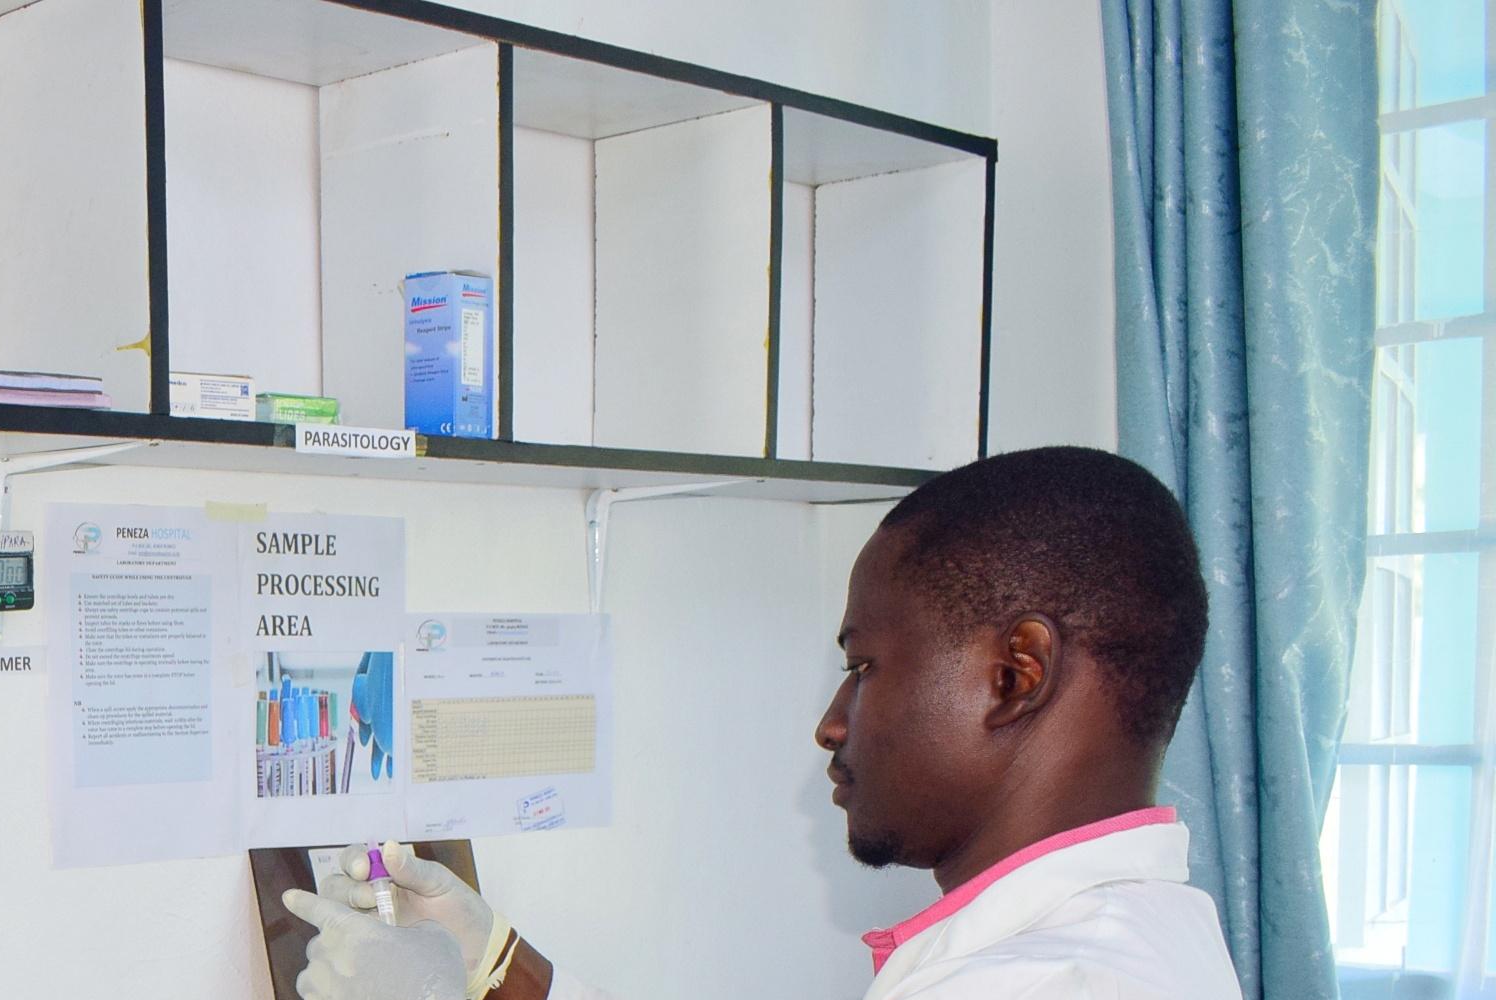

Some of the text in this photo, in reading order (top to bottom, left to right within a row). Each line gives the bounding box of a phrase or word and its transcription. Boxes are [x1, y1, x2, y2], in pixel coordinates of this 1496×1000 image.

[411, 295, 448, 307] Mission
[304, 430, 410, 451] PARASITOLOGY
[116, 527, 192, 540] PENEZA HOSPITAL
[256, 531, 337, 556] SAMPLE
[256, 573, 380, 597] PROCESSING
[256, 614, 313, 637] AREA
